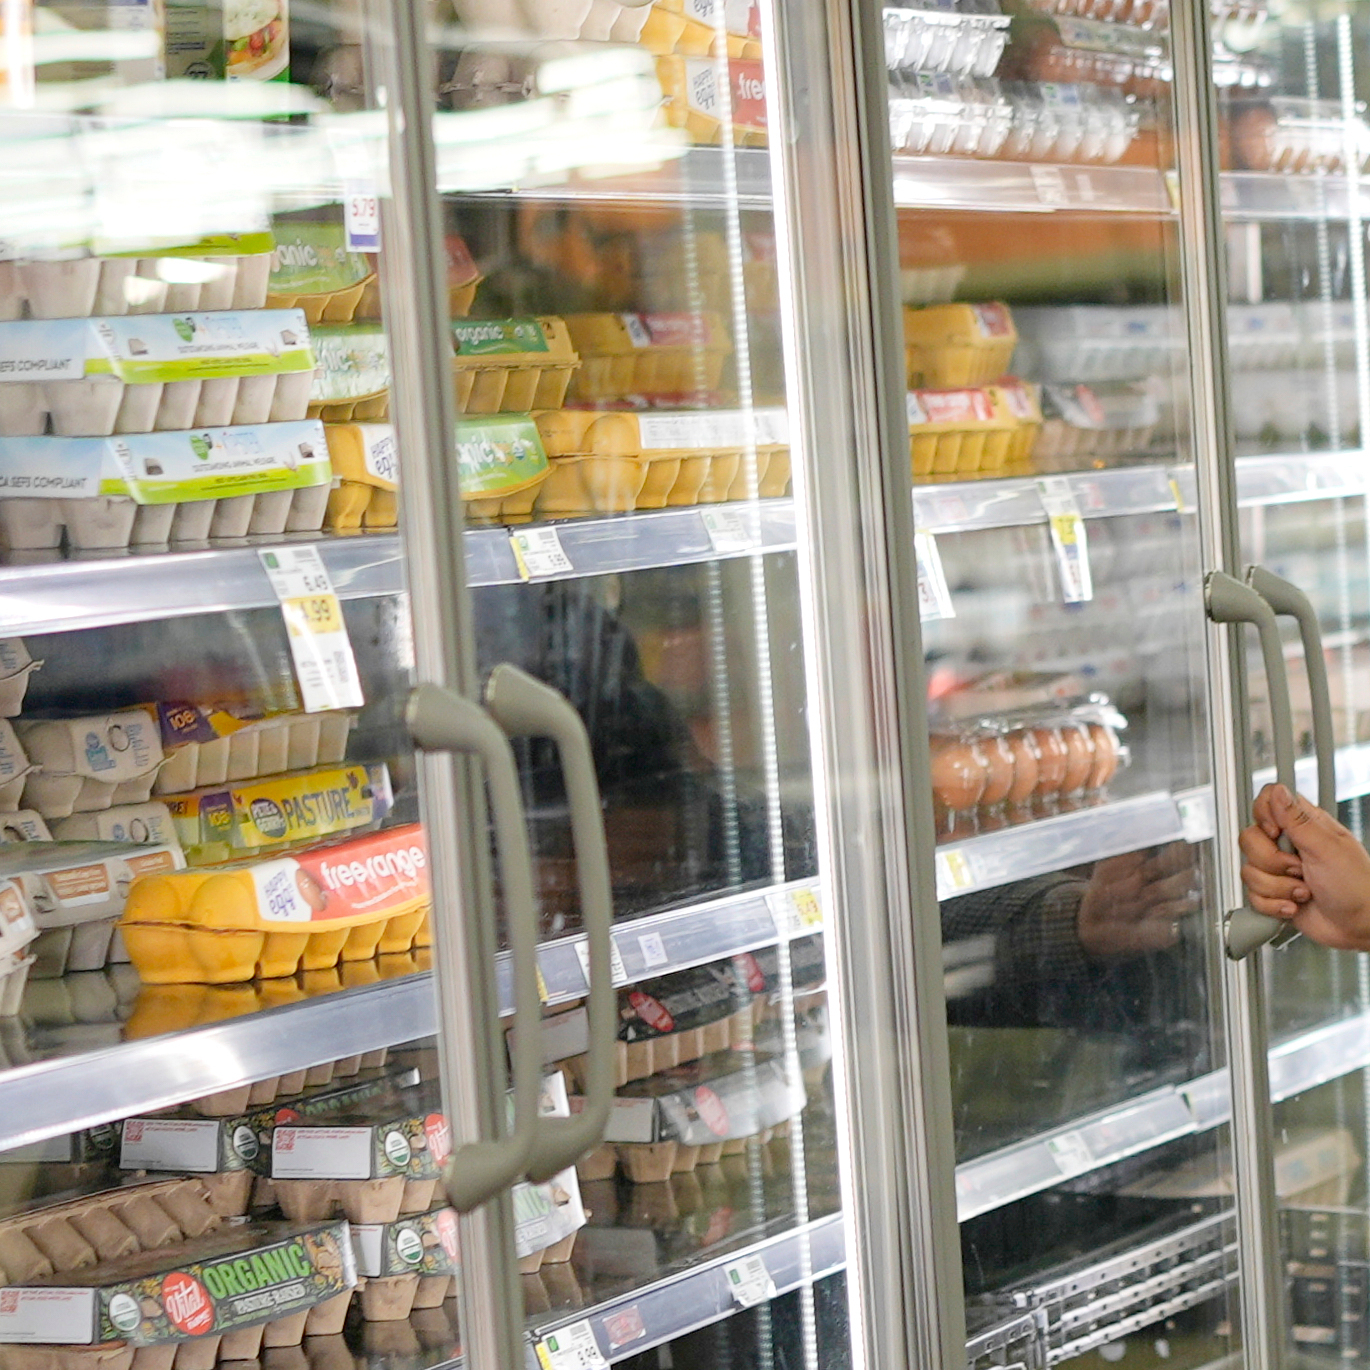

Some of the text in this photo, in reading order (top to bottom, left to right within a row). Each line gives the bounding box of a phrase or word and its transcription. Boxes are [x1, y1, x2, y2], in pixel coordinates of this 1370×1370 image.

[18, 357, 72, 371] COMPLIANT
[33, 475, 88, 490] COMPLIANT
[281, 787, 352, 831] PASTURE
[202, 1243, 311, 1300] ORGANIC
[165, 1280, 206, 1324] Vital
